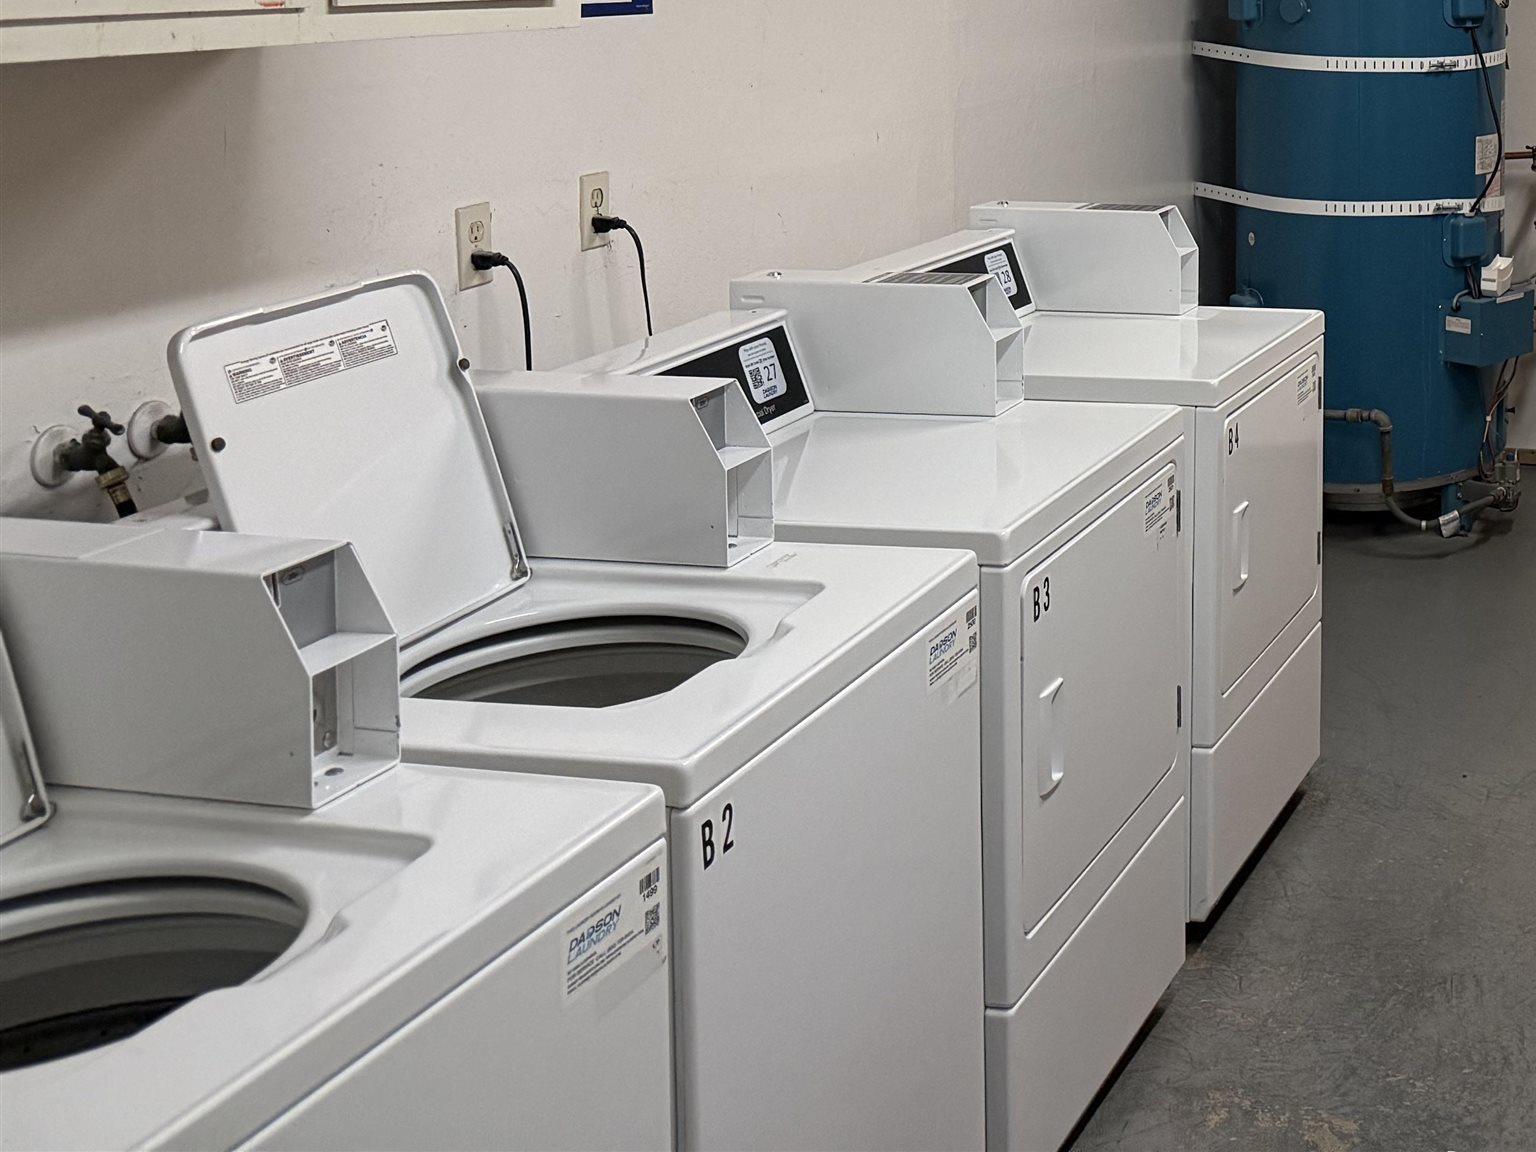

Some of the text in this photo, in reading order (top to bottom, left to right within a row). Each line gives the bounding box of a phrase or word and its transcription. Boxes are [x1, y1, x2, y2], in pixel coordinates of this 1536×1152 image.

[1001, 270, 1012, 284] 28
[764, 363, 777, 381] 27
[764, 404, 776, 414] Dryer
[569, 905, 621, 952] DADSON
[567, 916, 620, 965] LAUNDRY
